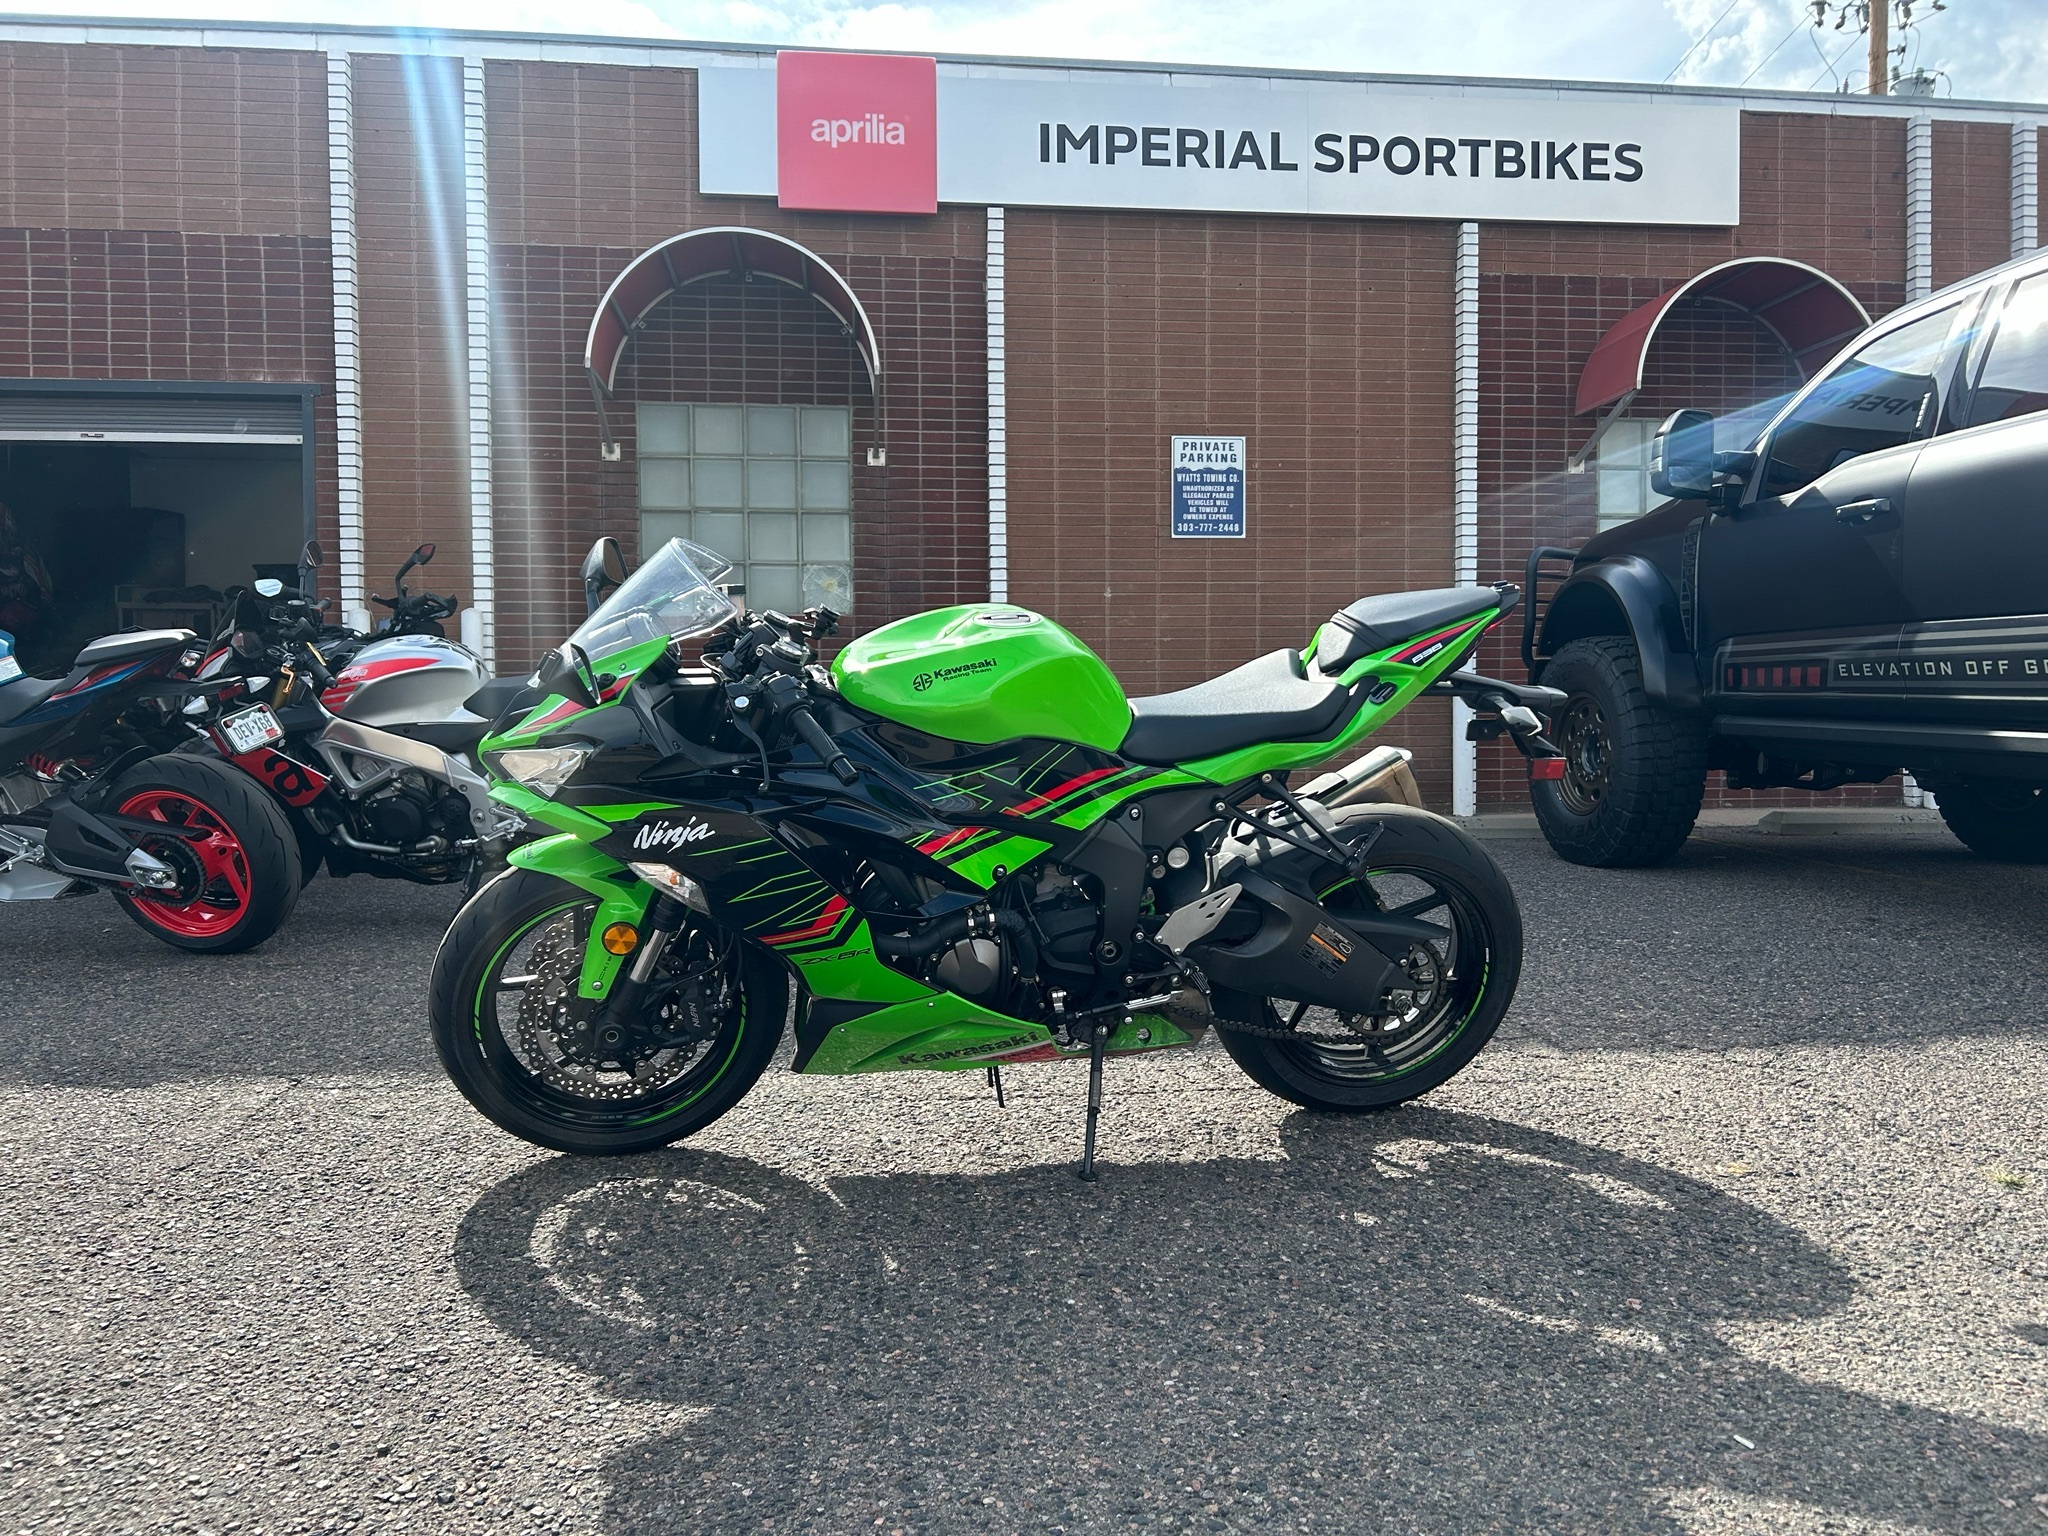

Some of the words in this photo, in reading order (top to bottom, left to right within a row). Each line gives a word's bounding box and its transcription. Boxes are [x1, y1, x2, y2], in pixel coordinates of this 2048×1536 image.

[810, 113, 905, 148] aprilia
[1039, 123, 1298, 172] IMPERIAL
[1313, 132, 1644, 182] SPORTBIKES
[1182, 441, 1235, 452] PRIVATE
[1180, 453, 1237, 463] PARKING
[1176, 473, 1201, 482] WYATTS
[1203, 473, 1227, 482] TOWING
[1229, 474, 1240, 483] CO.
[1177, 523, 1239, 532] 303-777-2448
[933, 658, 998, 679] Kawasaki
[942, 671, 970, 682] Racing
[971, 667, 992, 676] Team
[1838, 660, 1953, 677] ELEVATION
[1965, 660, 2009, 675] OFF
[633, 815, 716, 854] Ninja
[897, 1031, 1040, 1065] Kawasaki
